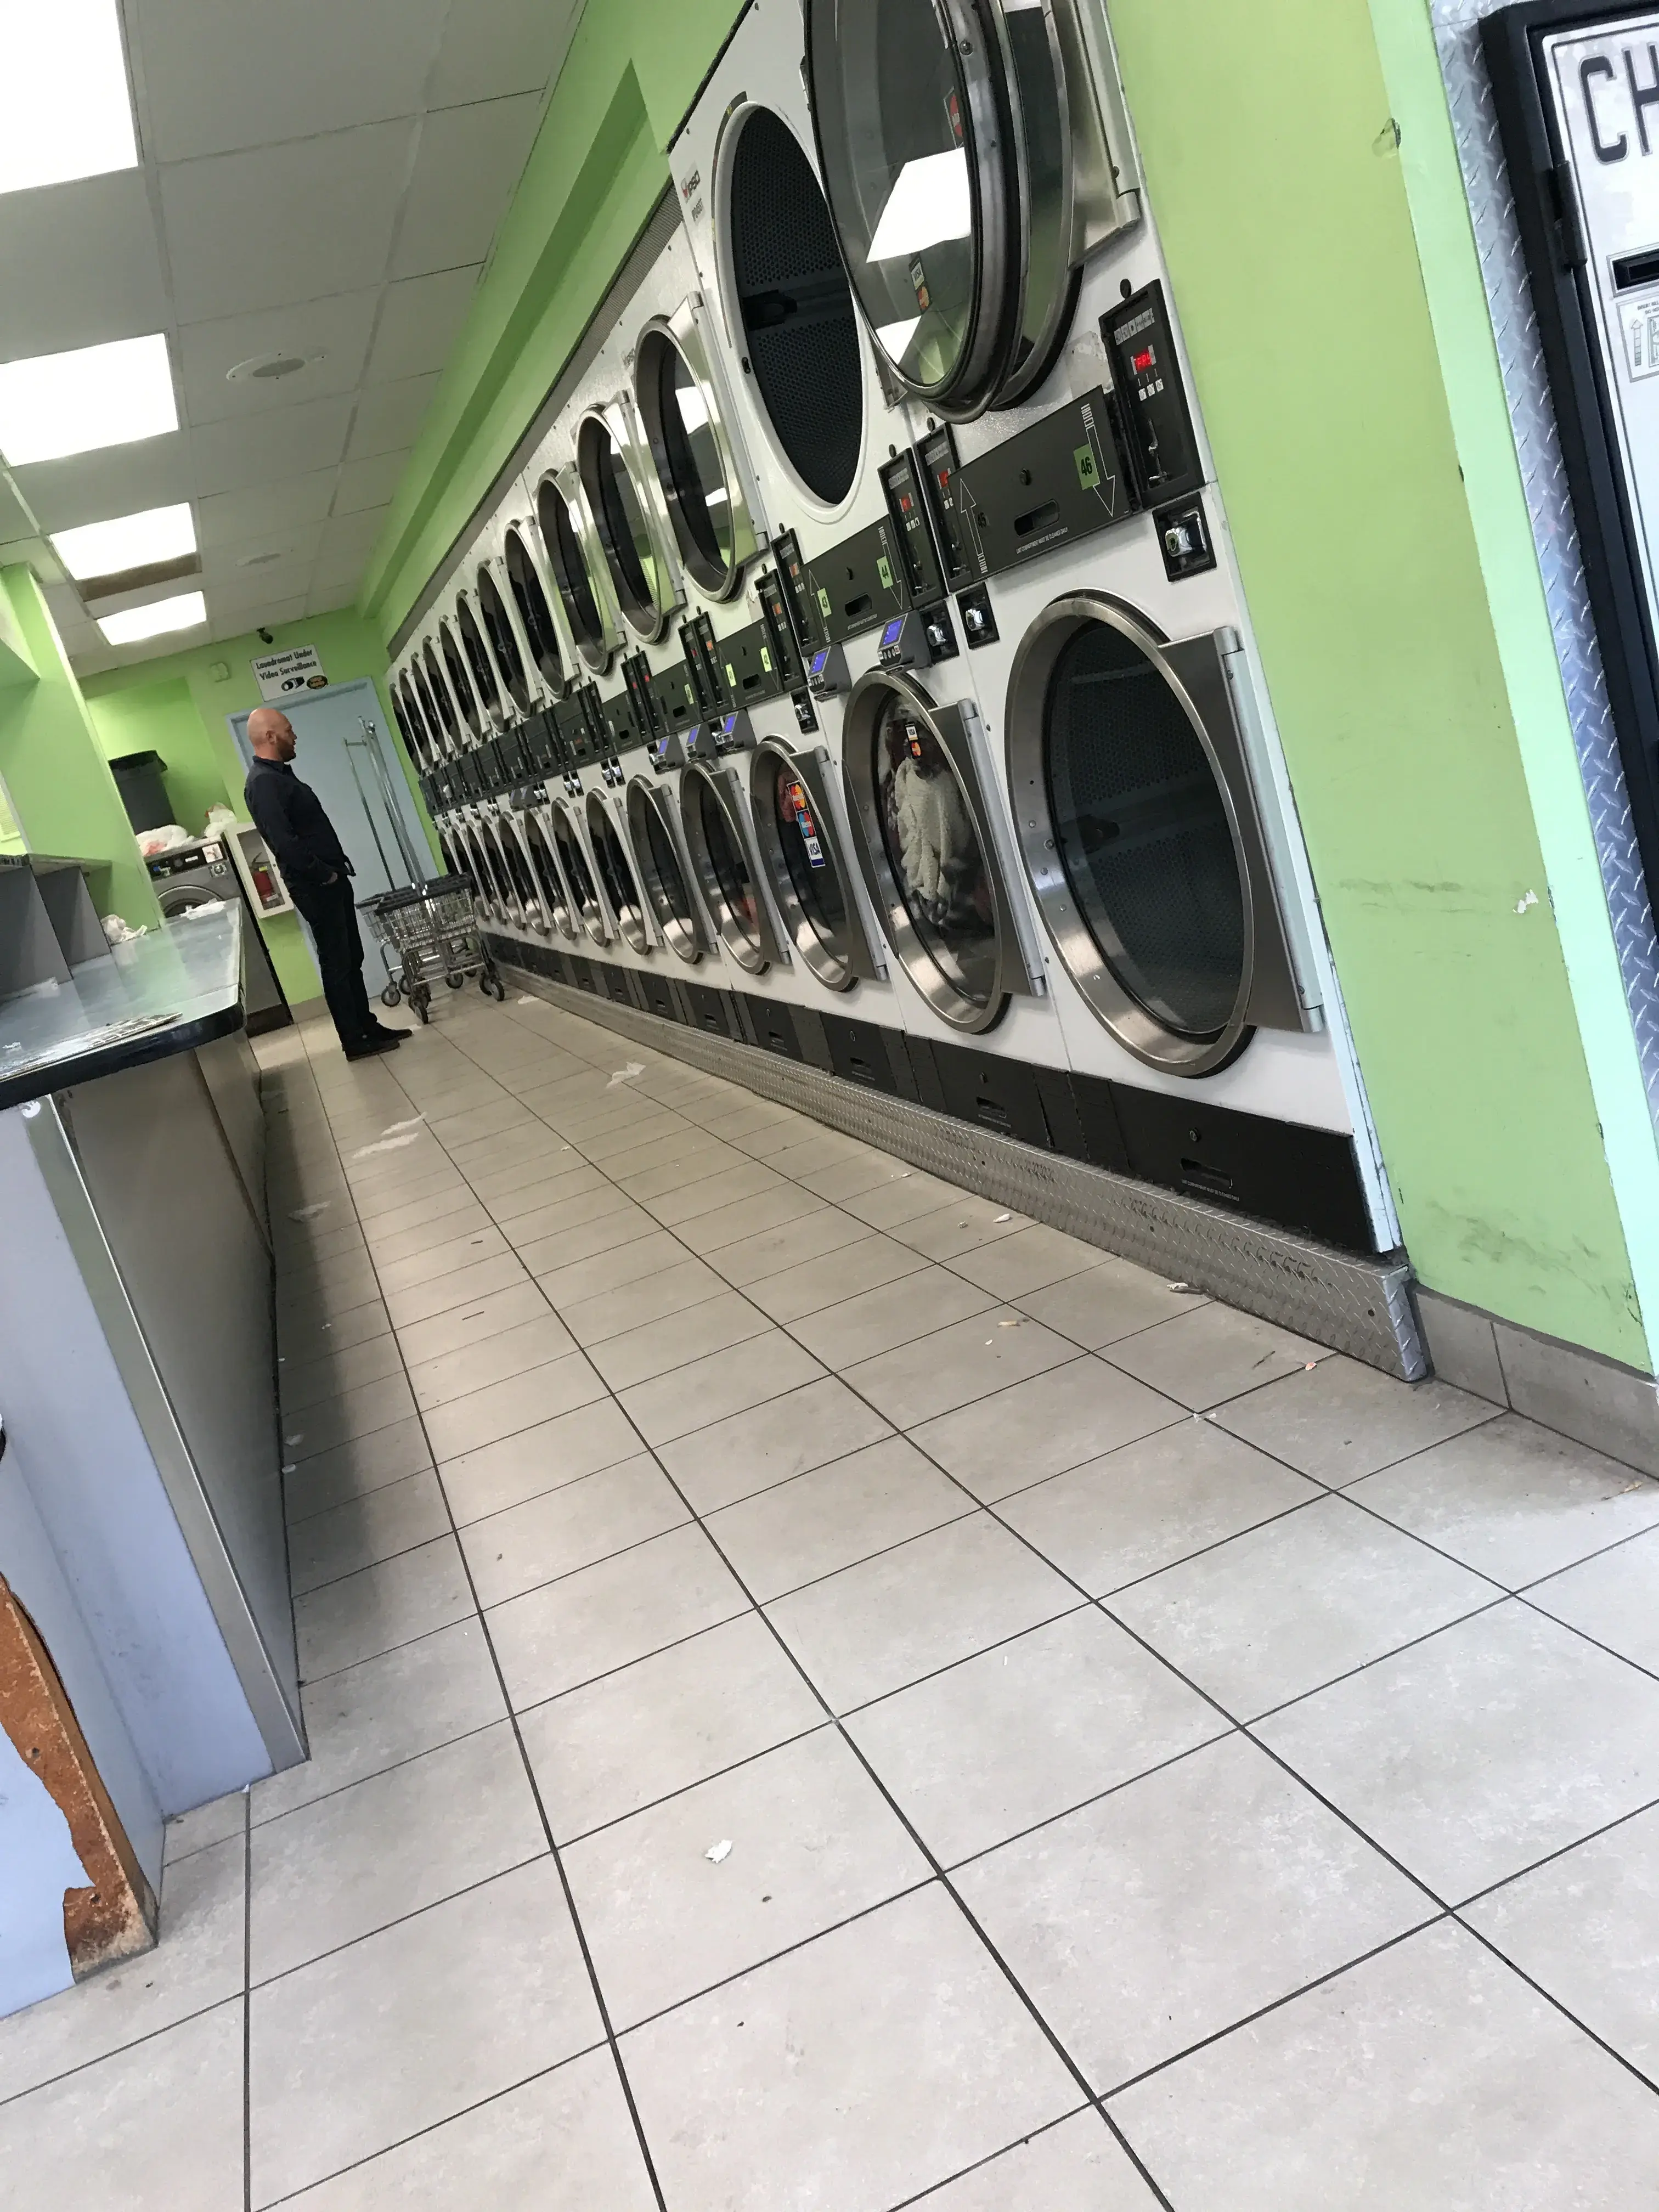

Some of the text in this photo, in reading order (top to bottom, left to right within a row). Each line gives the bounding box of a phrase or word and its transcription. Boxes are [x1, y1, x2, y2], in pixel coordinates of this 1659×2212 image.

[1081, 456, 1093, 476] 46
[978, 511, 987, 528] 45
[882, 565, 889, 579] 44
[255, 648, 313, 670] Laundromat Under
[259, 661, 317, 681] Video Surveillance
[808, 842, 821, 856] VISA
